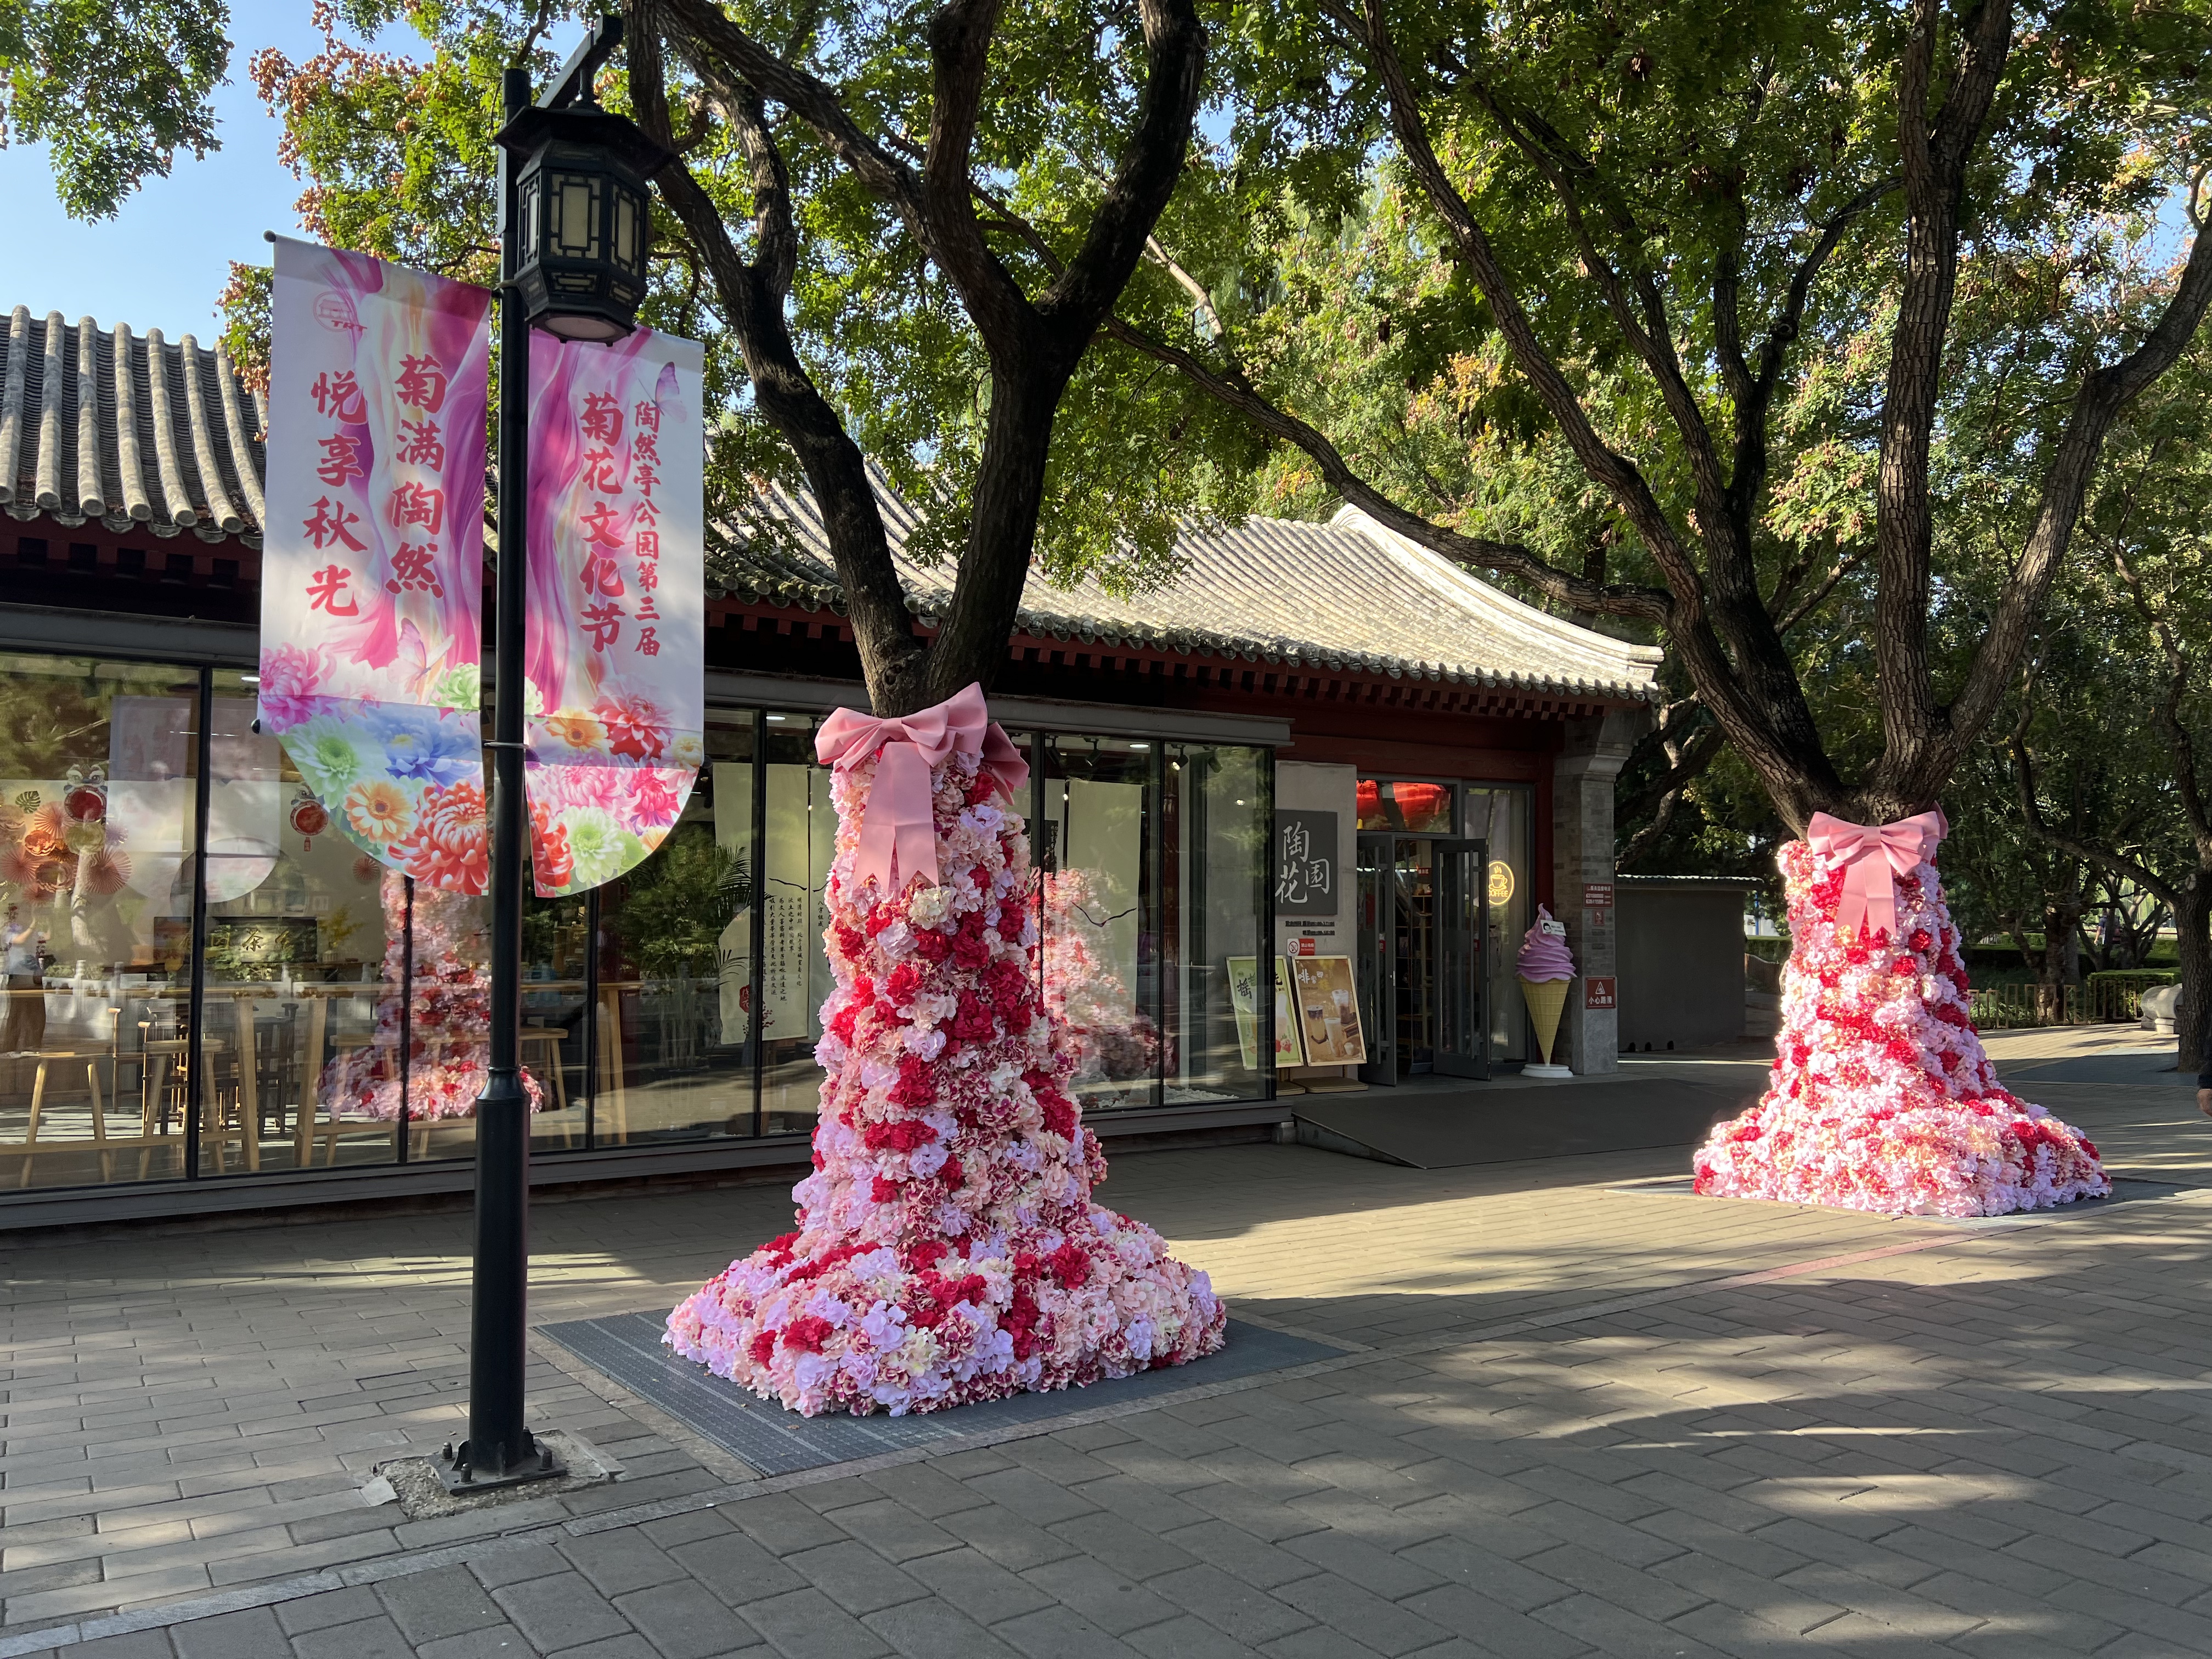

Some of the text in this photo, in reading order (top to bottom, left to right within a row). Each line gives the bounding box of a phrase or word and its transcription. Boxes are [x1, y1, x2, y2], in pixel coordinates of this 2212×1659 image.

[331, 319, 368, 332] TRT
[302, 370, 369, 617] 悦享秋光
[385, 353, 448, 600] 菊满陶然
[579, 391, 626, 653] 菊花文化节
[633, 400, 662, 658] 陶然亭公园第三届
